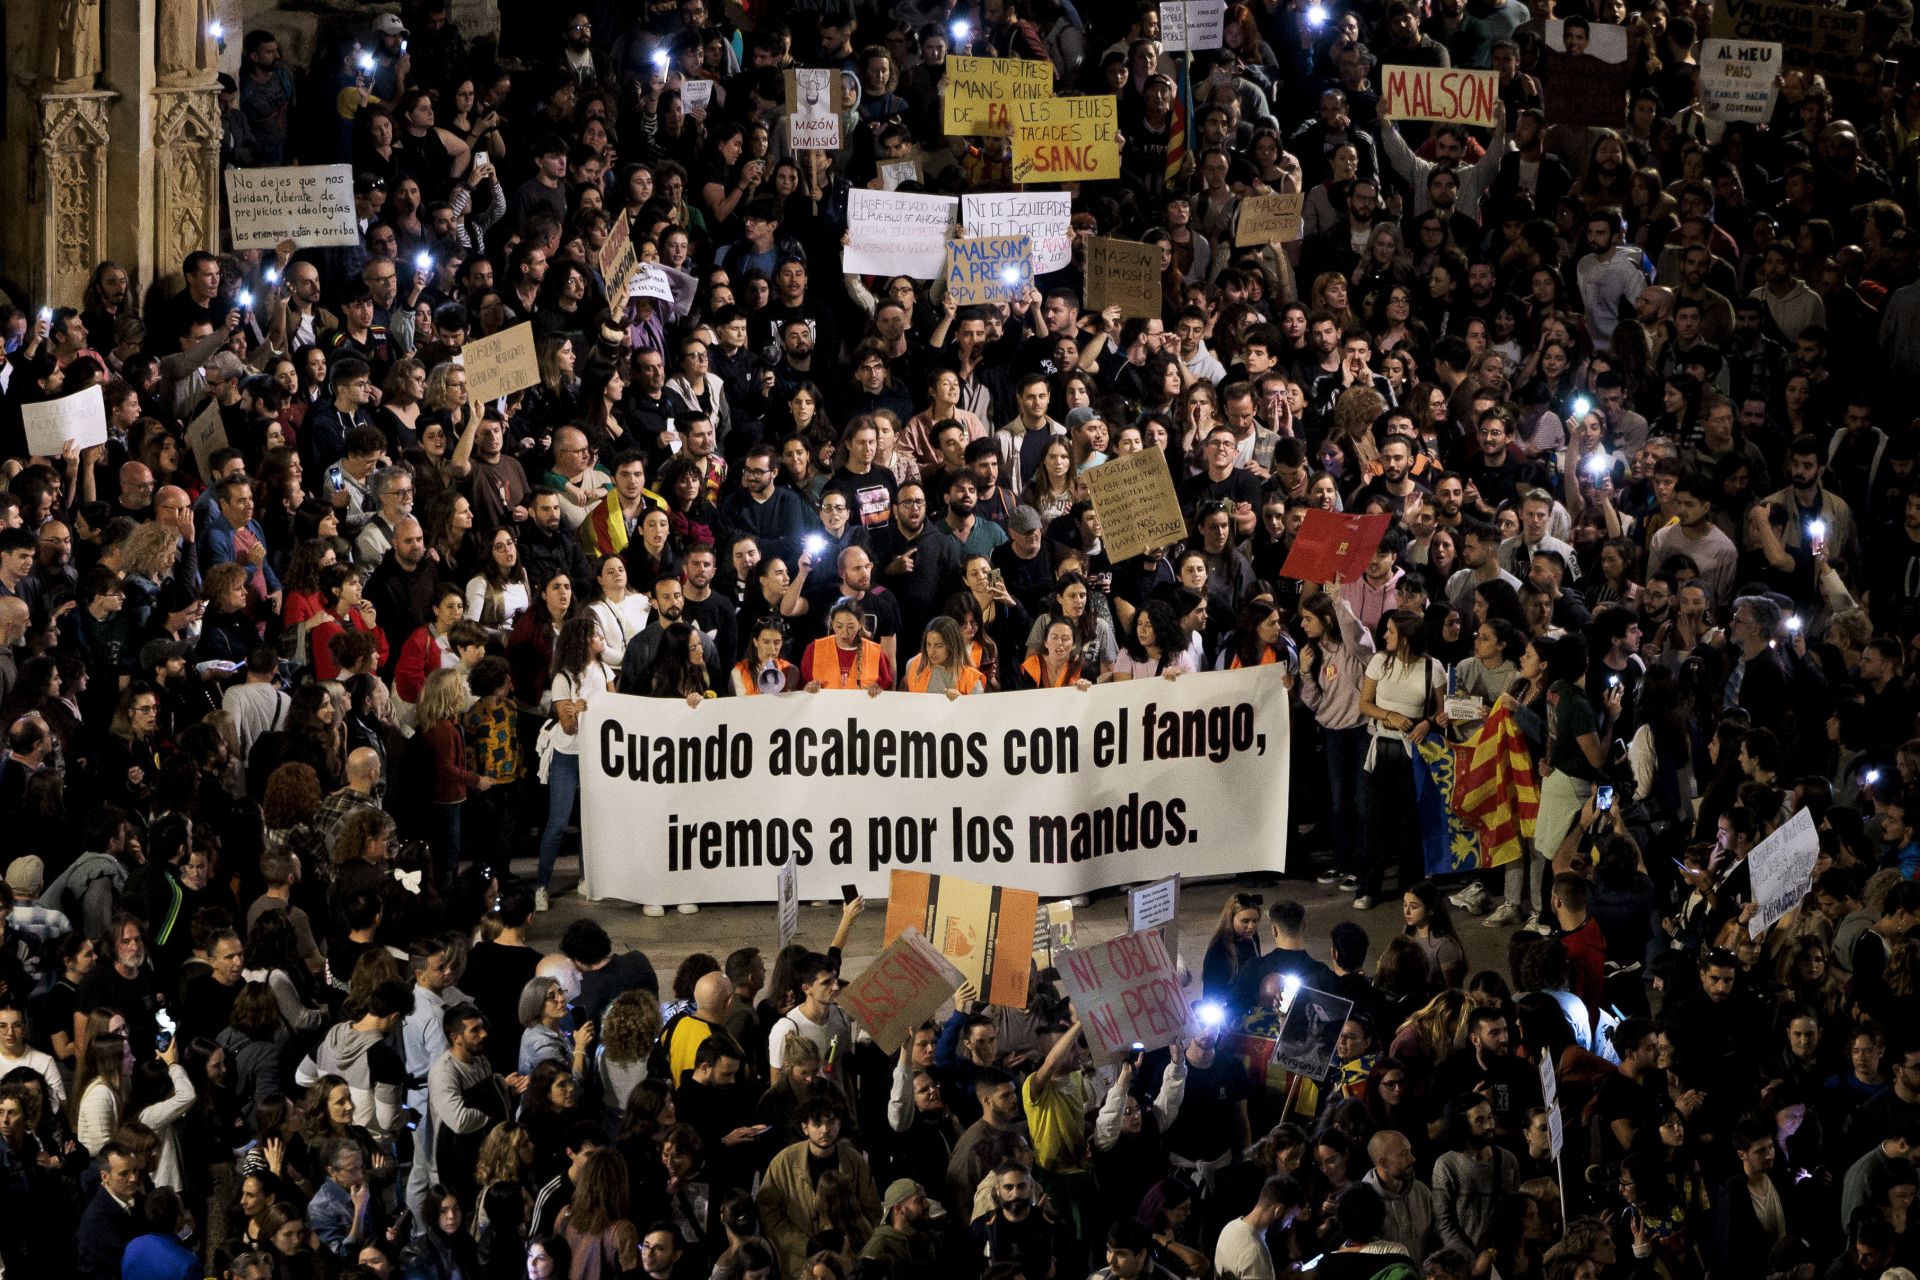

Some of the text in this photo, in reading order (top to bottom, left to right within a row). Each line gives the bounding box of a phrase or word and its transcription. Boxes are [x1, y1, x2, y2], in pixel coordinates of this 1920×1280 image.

[1718, 45, 1772, 62] AL MEU
[955, 59, 1049, 81] LES NOSTRES
[953, 79, 1051, 99] MANS PLENES
[1387, 71, 1494, 123] MALSON
[953, 102, 1008, 129] DE FA
[1019, 99, 1113, 123] LES TEUES
[795, 117, 834, 130] MAZÓN
[1019, 123, 1111, 142] TACADES DE
[792, 132, 838, 147] DIMISSIÓ
[1033, 143, 1098, 173] SANG
[232, 174, 344, 191] No dejes que nos
[320, 188, 336, 201] de
[853, 193, 893, 211] HABEIS
[235, 207, 283, 223] prejuicios
[297, 202, 351, 220] ideologías
[853, 211, 866, 221] EL
[867, 211, 903, 223] PUEBLO
[904, 214, 914, 222] SE
[991, 201, 1004, 217] DE
[1006, 197, 1071, 218] IZQUIERDAS
[253, 230, 288, 242] enemigos
[291, 224, 312, 237] están
[322, 222, 355, 237] arriba
[991, 222, 1004, 238] DE
[1007, 220, 1066, 238] DERECHAS
[951, 265, 964, 282] A
[1088, 470, 1103, 484] LA
[1103, 481, 1120, 493] QUE
[1123, 466, 1163, 487] NUESTRAS
[1102, 518, 1121, 529] CON
[1136, 517, 1156, 529] NOS
[1147, 519, 1181, 537] MATADO
[600, 702, 1267, 785] Cuando acabemos con el fango,
[668, 791, 1198, 872] iremos a por los mandos.
[1068, 950, 1103, 994] NI
[1107, 930, 1168, 981] OBLIT
[1088, 1002, 1124, 1052] NI
